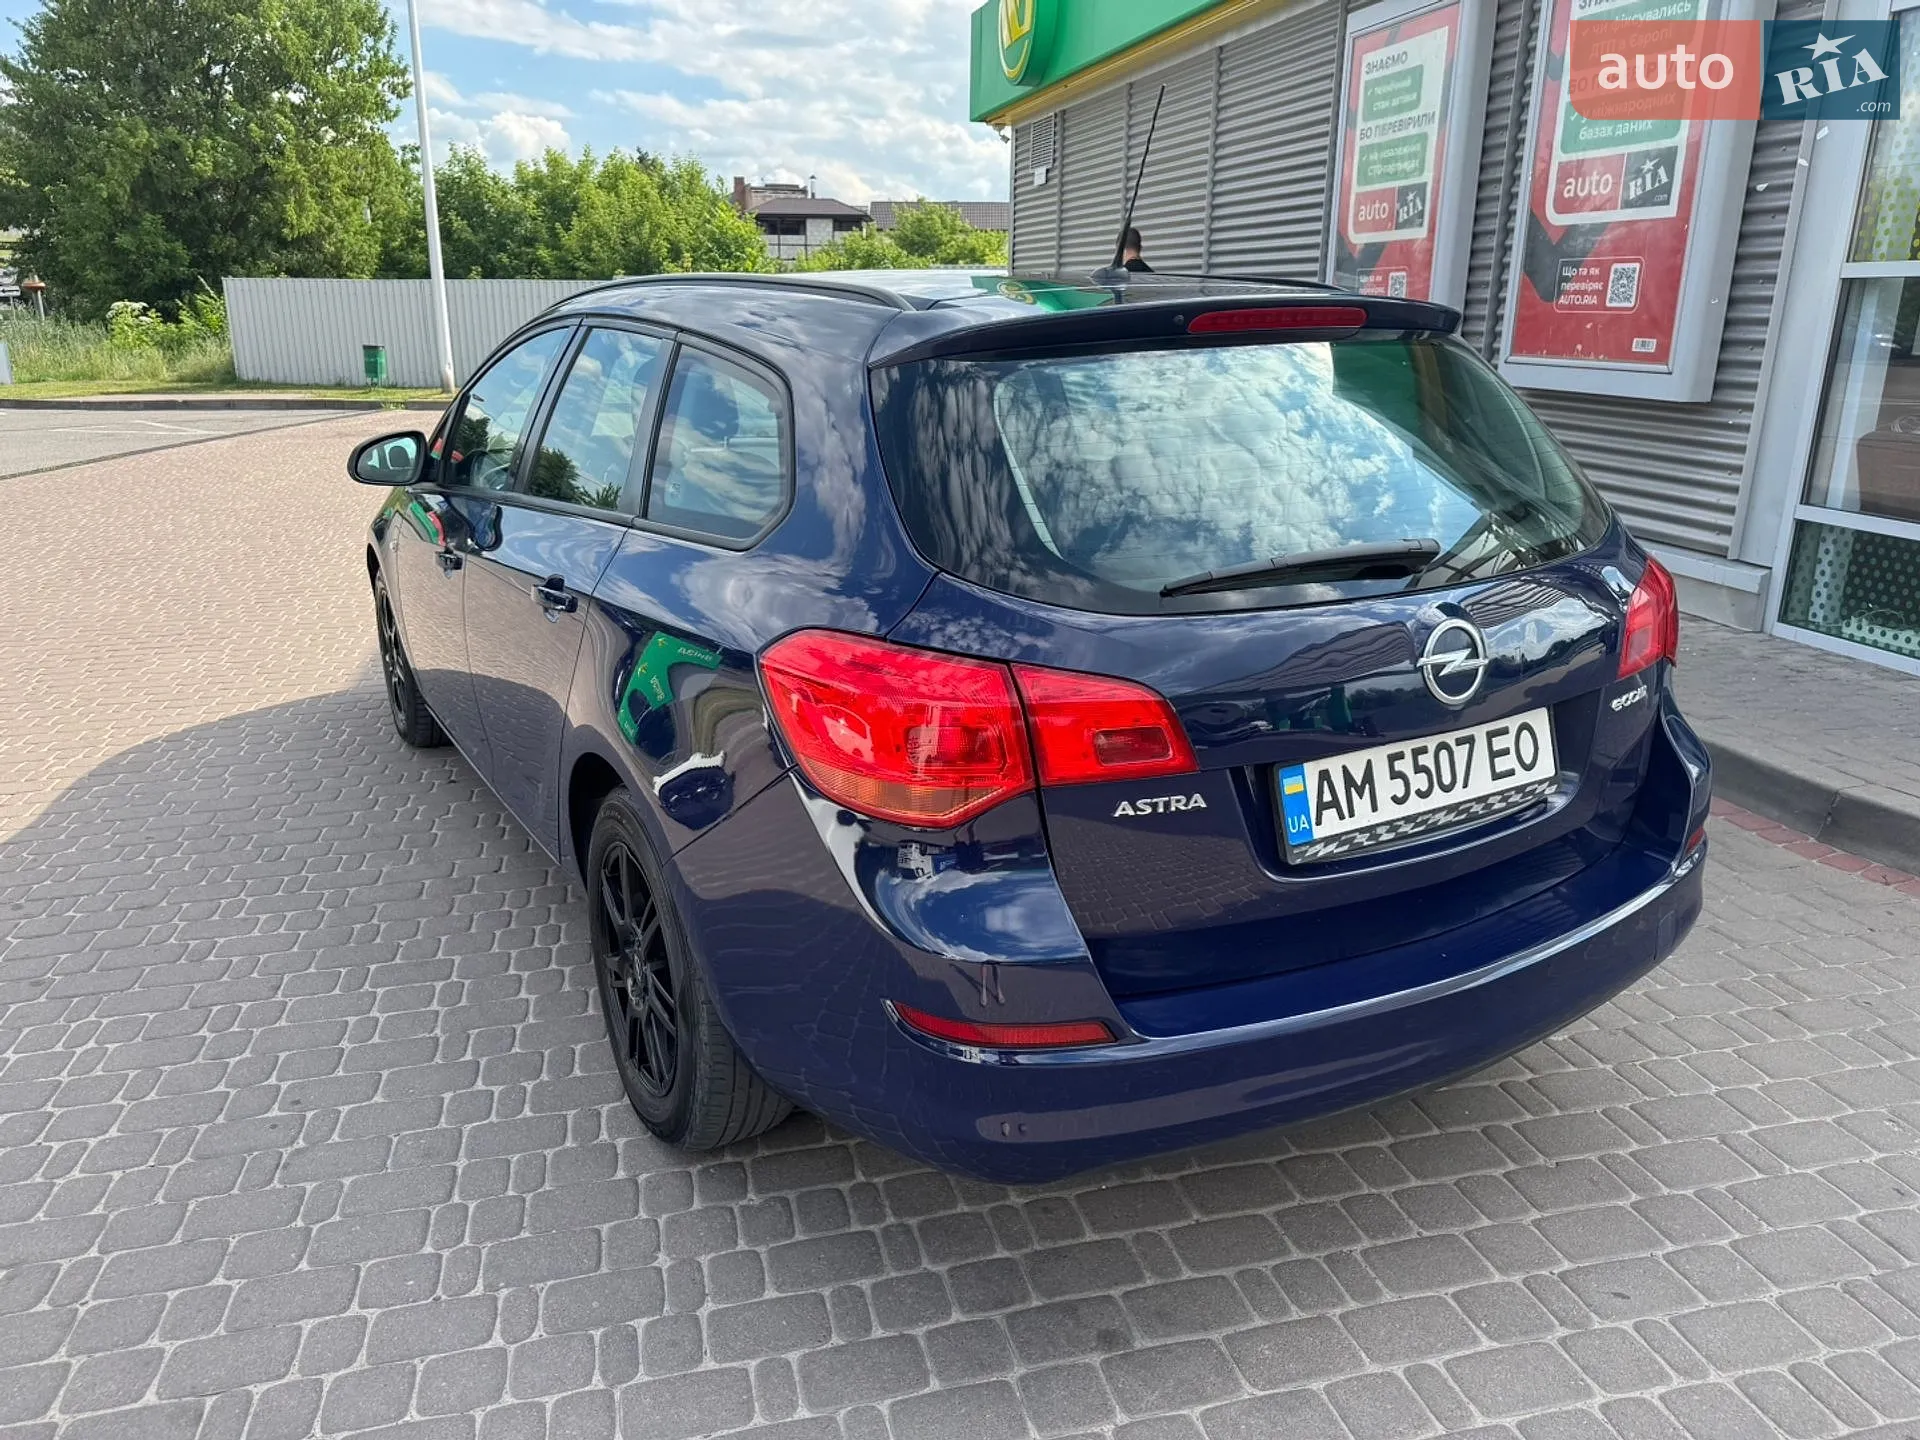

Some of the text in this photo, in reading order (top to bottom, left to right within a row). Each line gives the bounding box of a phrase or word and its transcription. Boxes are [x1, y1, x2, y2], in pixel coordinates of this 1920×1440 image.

[1365, 51, 1408, 75] ЗНАЄМО
[1563, 171, 1612, 198] auto
[1629, 165, 1669, 200] RIA
[1358, 200, 1388, 221] auto
[1558, 294, 1598, 305] AUTO.RIA
[1315, 721, 1539, 826] AM 5507 EO
[1113, 793, 1208, 817] ASTRA
[1288, 816, 1310, 834] UA
